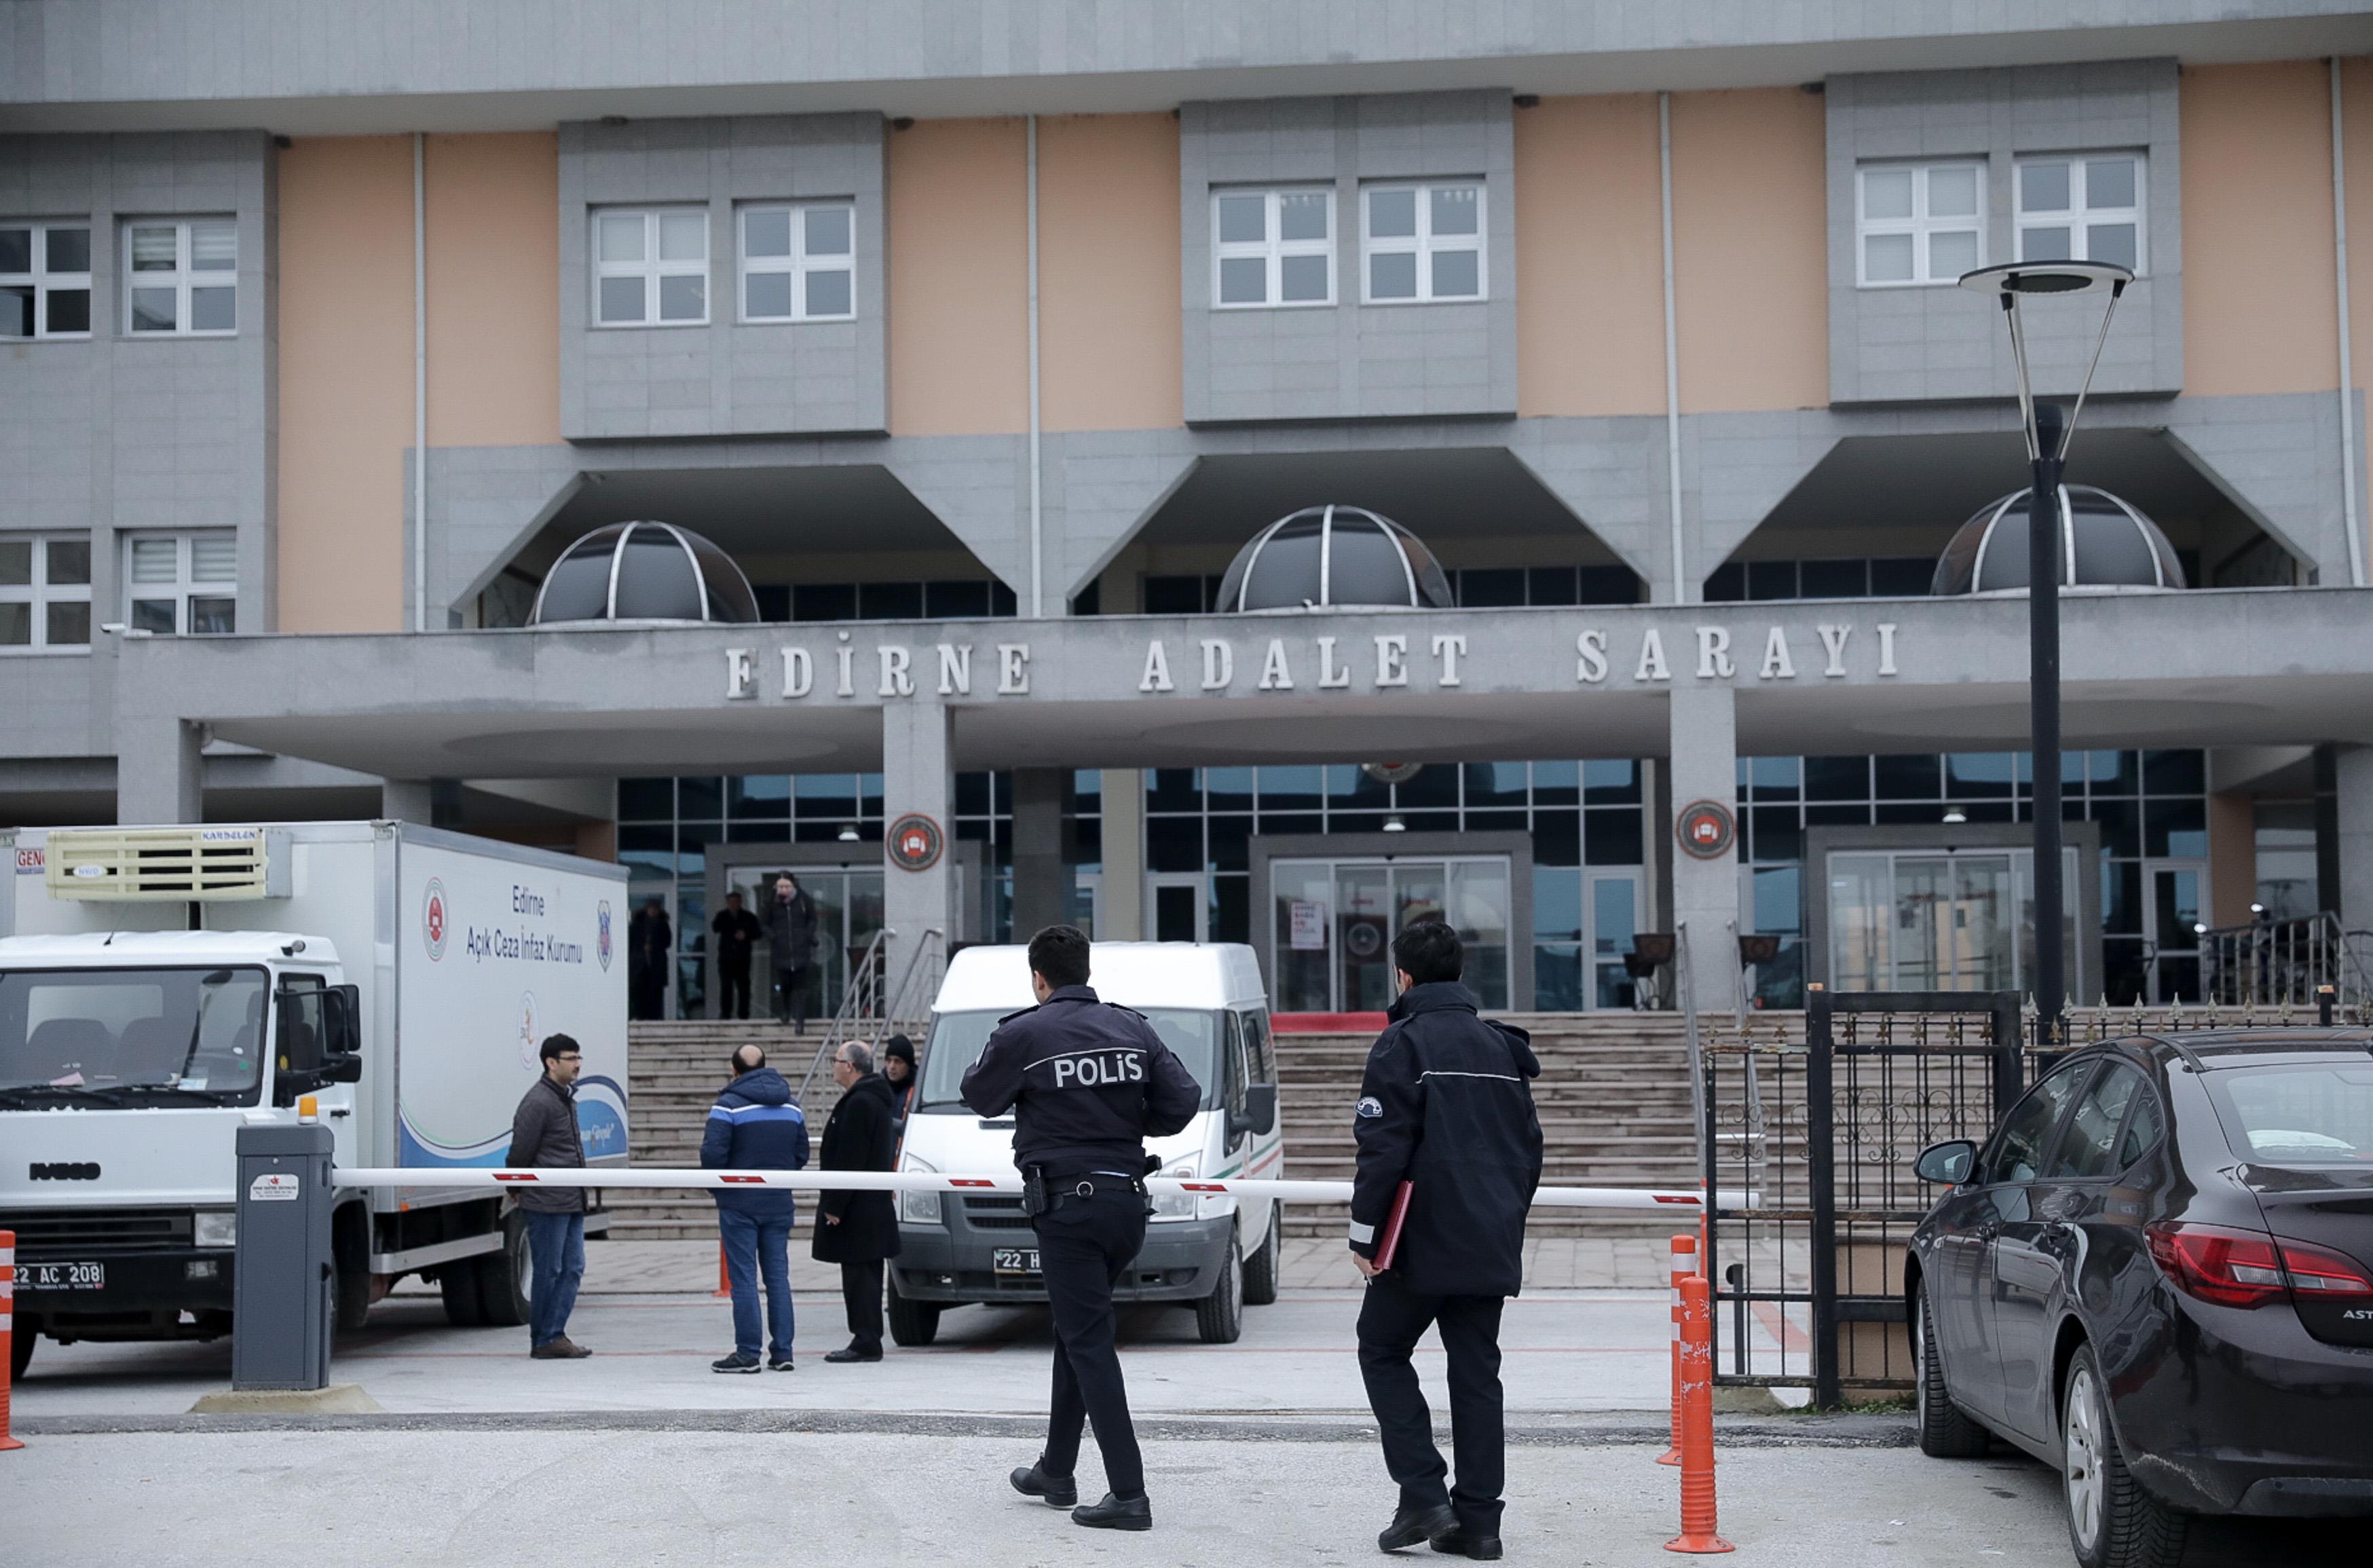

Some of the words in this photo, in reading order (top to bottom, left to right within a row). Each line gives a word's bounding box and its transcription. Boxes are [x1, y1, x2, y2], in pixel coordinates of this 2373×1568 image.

[1139, 634, 1467, 692] ADALET
[1576, 622, 1898, 683] SARAYI
[512, 884, 545, 916] Edirne
[467, 925, 491, 964] Açık
[494, 928, 519, 958] Ceza
[521, 923, 544, 960] İnfaz
[546, 933, 583, 964] Kurumu
[39, 1267, 60, 1284] AC
[69, 1265, 100, 1283] 208
[1003, 1253, 1022, 1268] 22
